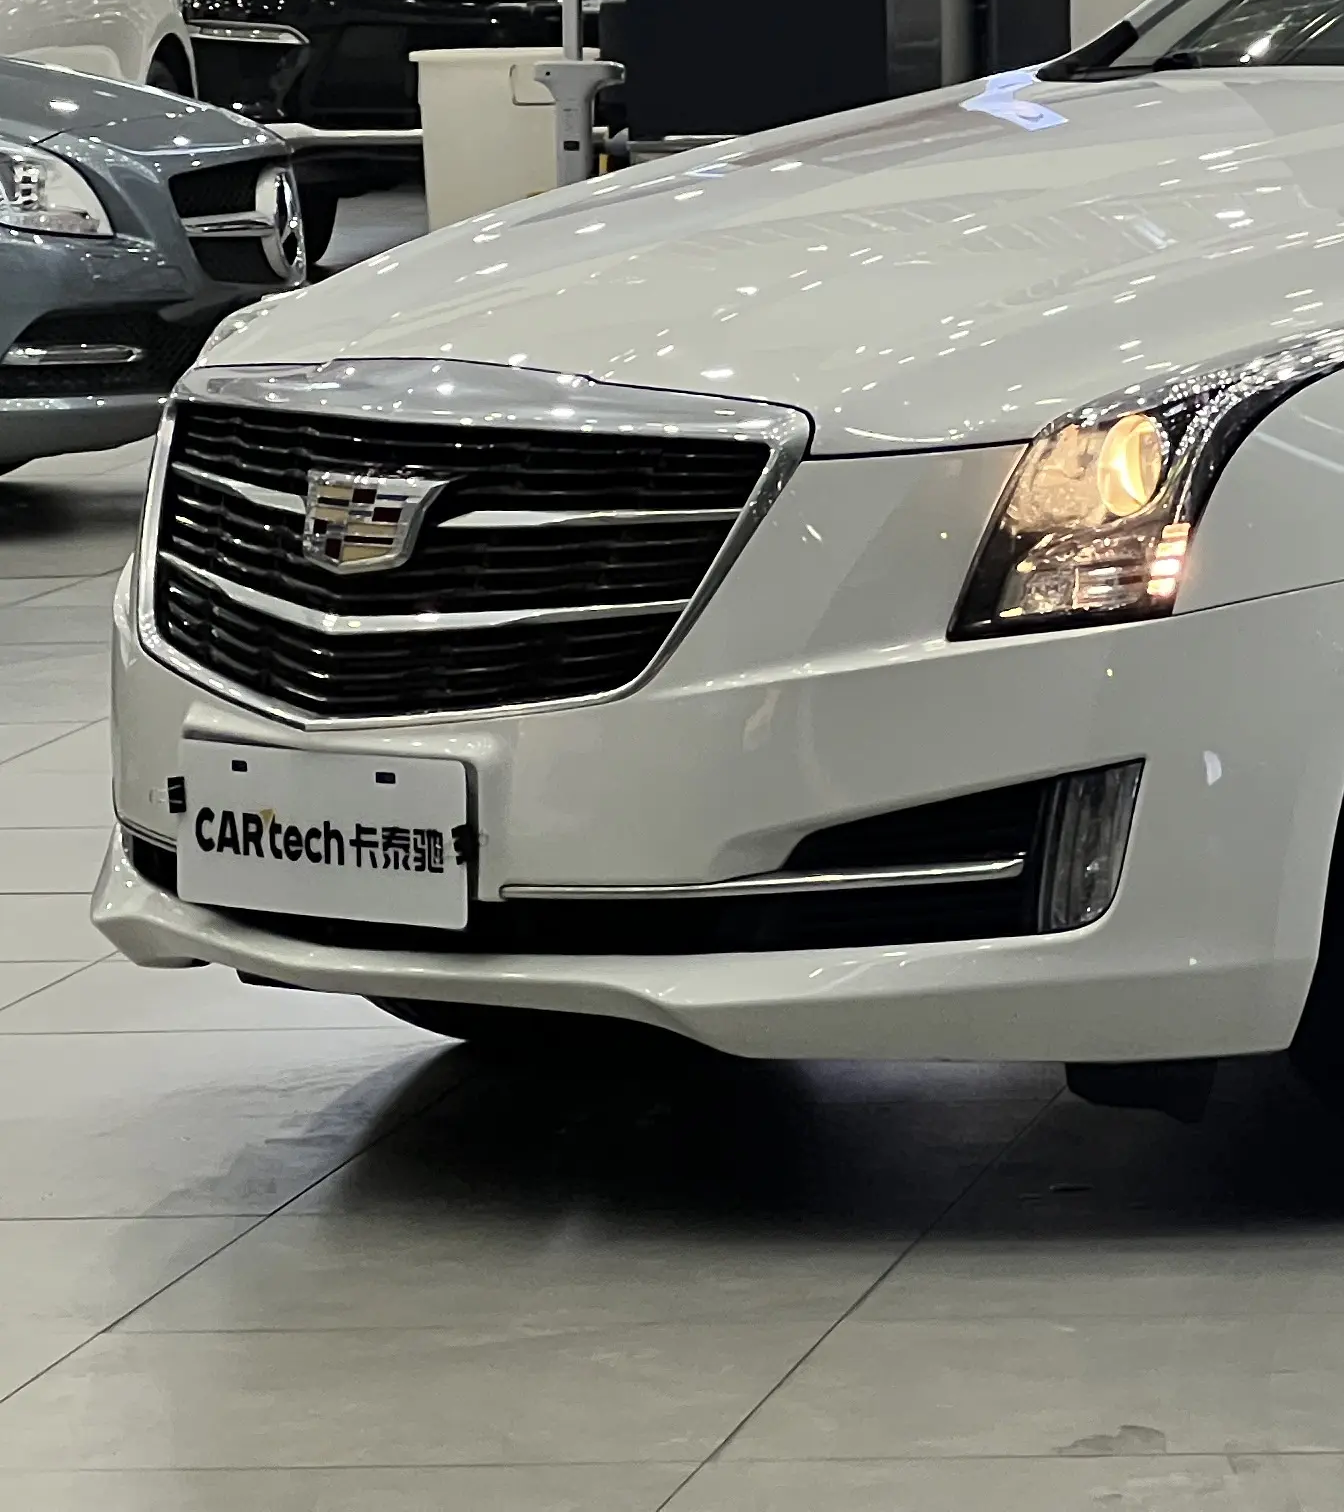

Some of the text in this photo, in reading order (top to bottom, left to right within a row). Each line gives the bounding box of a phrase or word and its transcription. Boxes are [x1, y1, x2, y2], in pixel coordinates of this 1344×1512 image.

[195, 807, 445, 874] CARtech 卡泰驰
